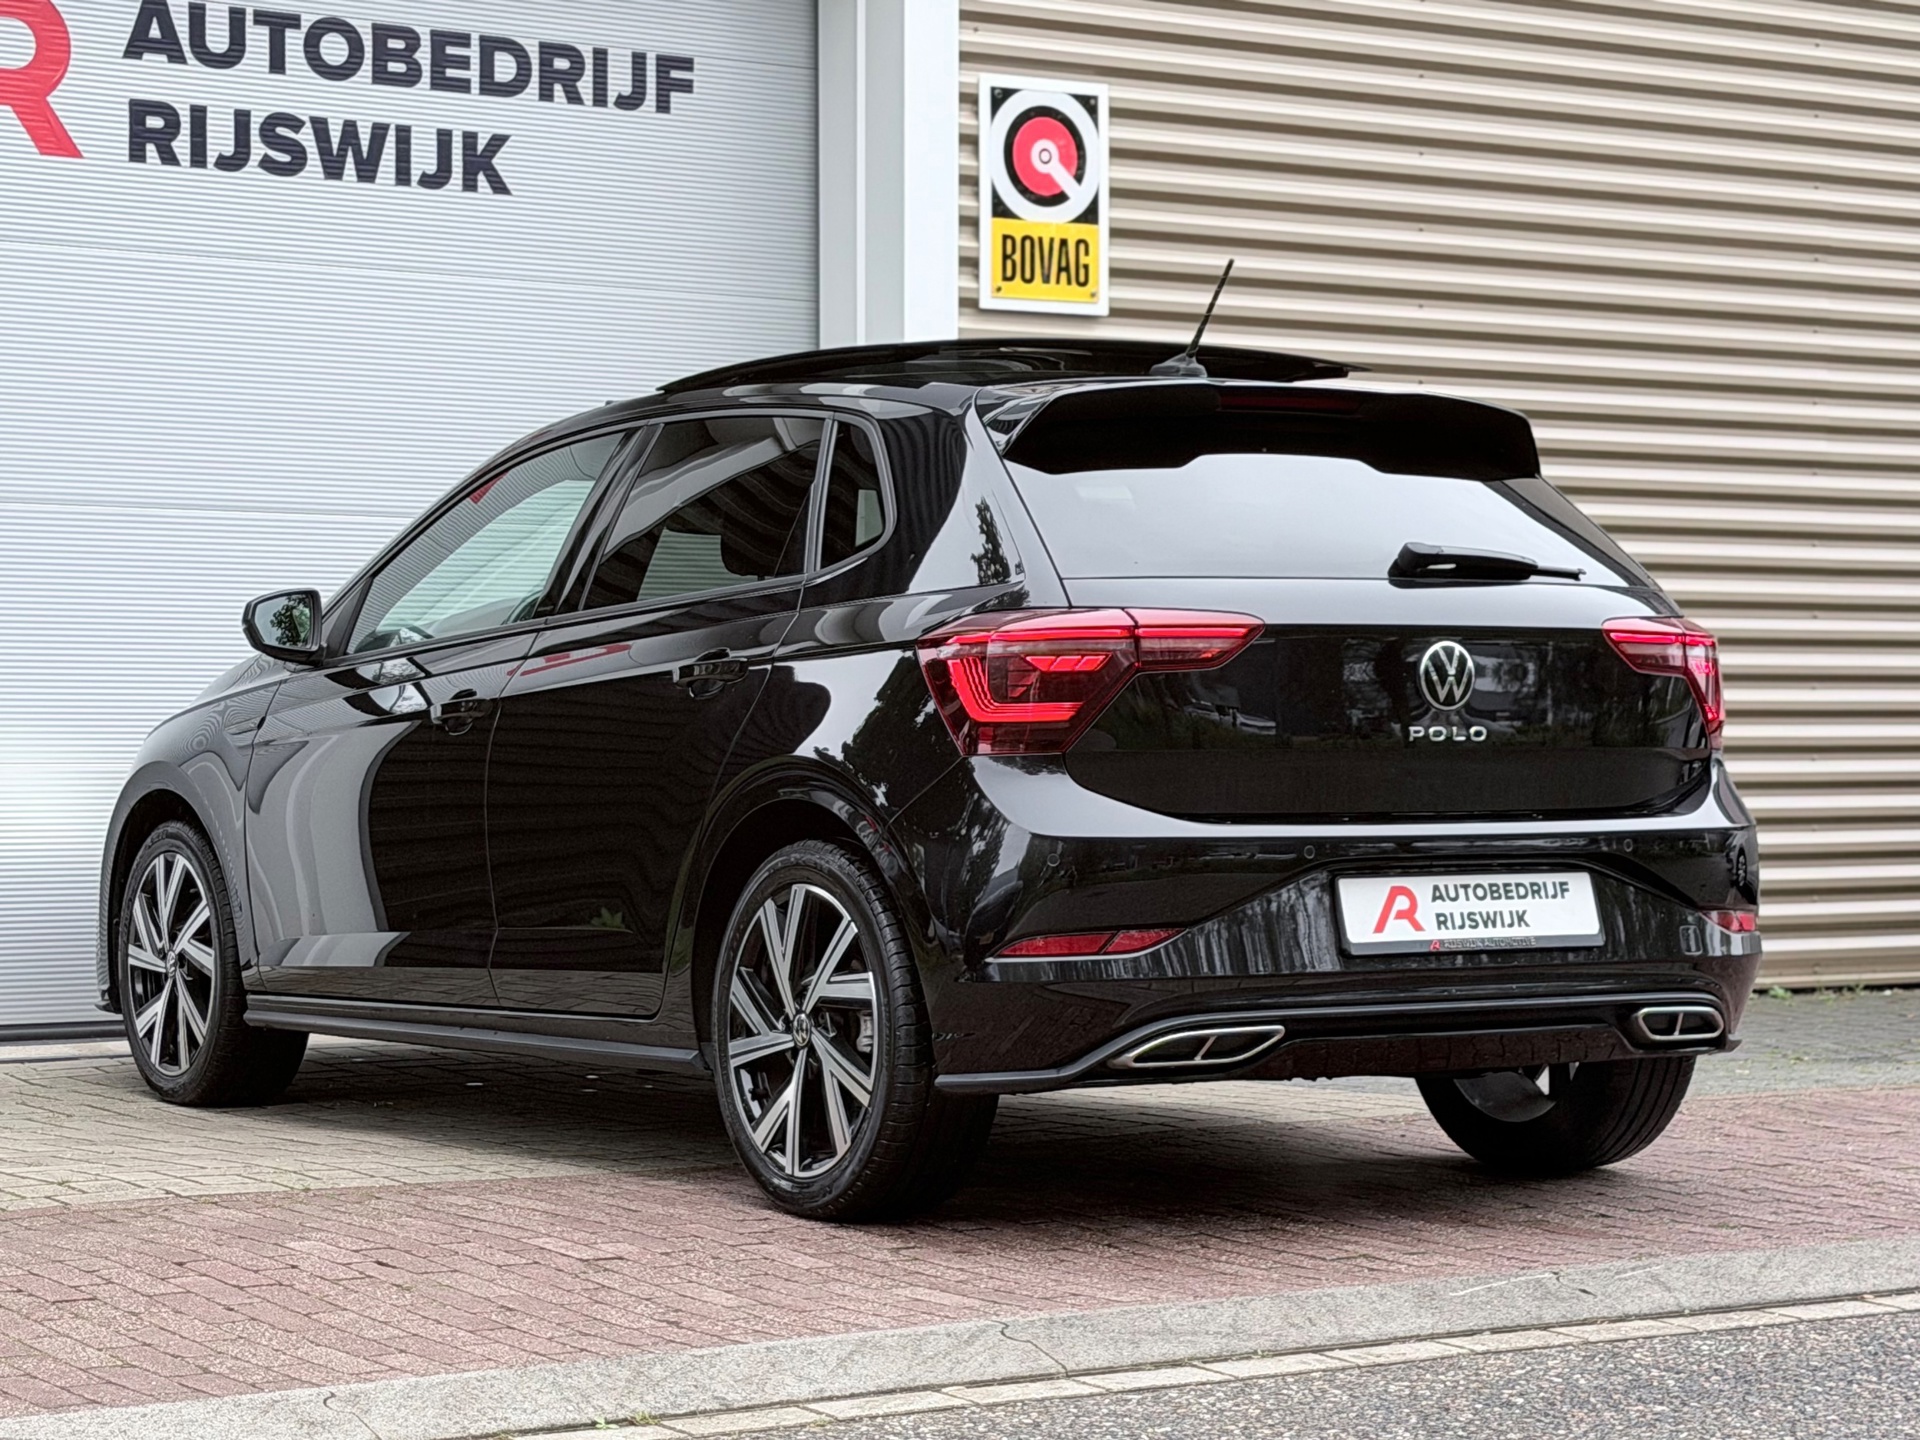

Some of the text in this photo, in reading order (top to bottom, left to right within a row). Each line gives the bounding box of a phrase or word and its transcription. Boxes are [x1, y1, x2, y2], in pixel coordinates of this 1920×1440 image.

[122, 0, 695, 114] AUTOBEDRIJF
[128, 98, 513, 196] RIJSWIJK
[1001, 234, 1090, 287] BOVAG
[1408, 726, 1487, 741] POLO
[1431, 881, 1570, 903] AUTOBEDRIJF
[1434, 910, 1531, 931] RIJSWIJK
